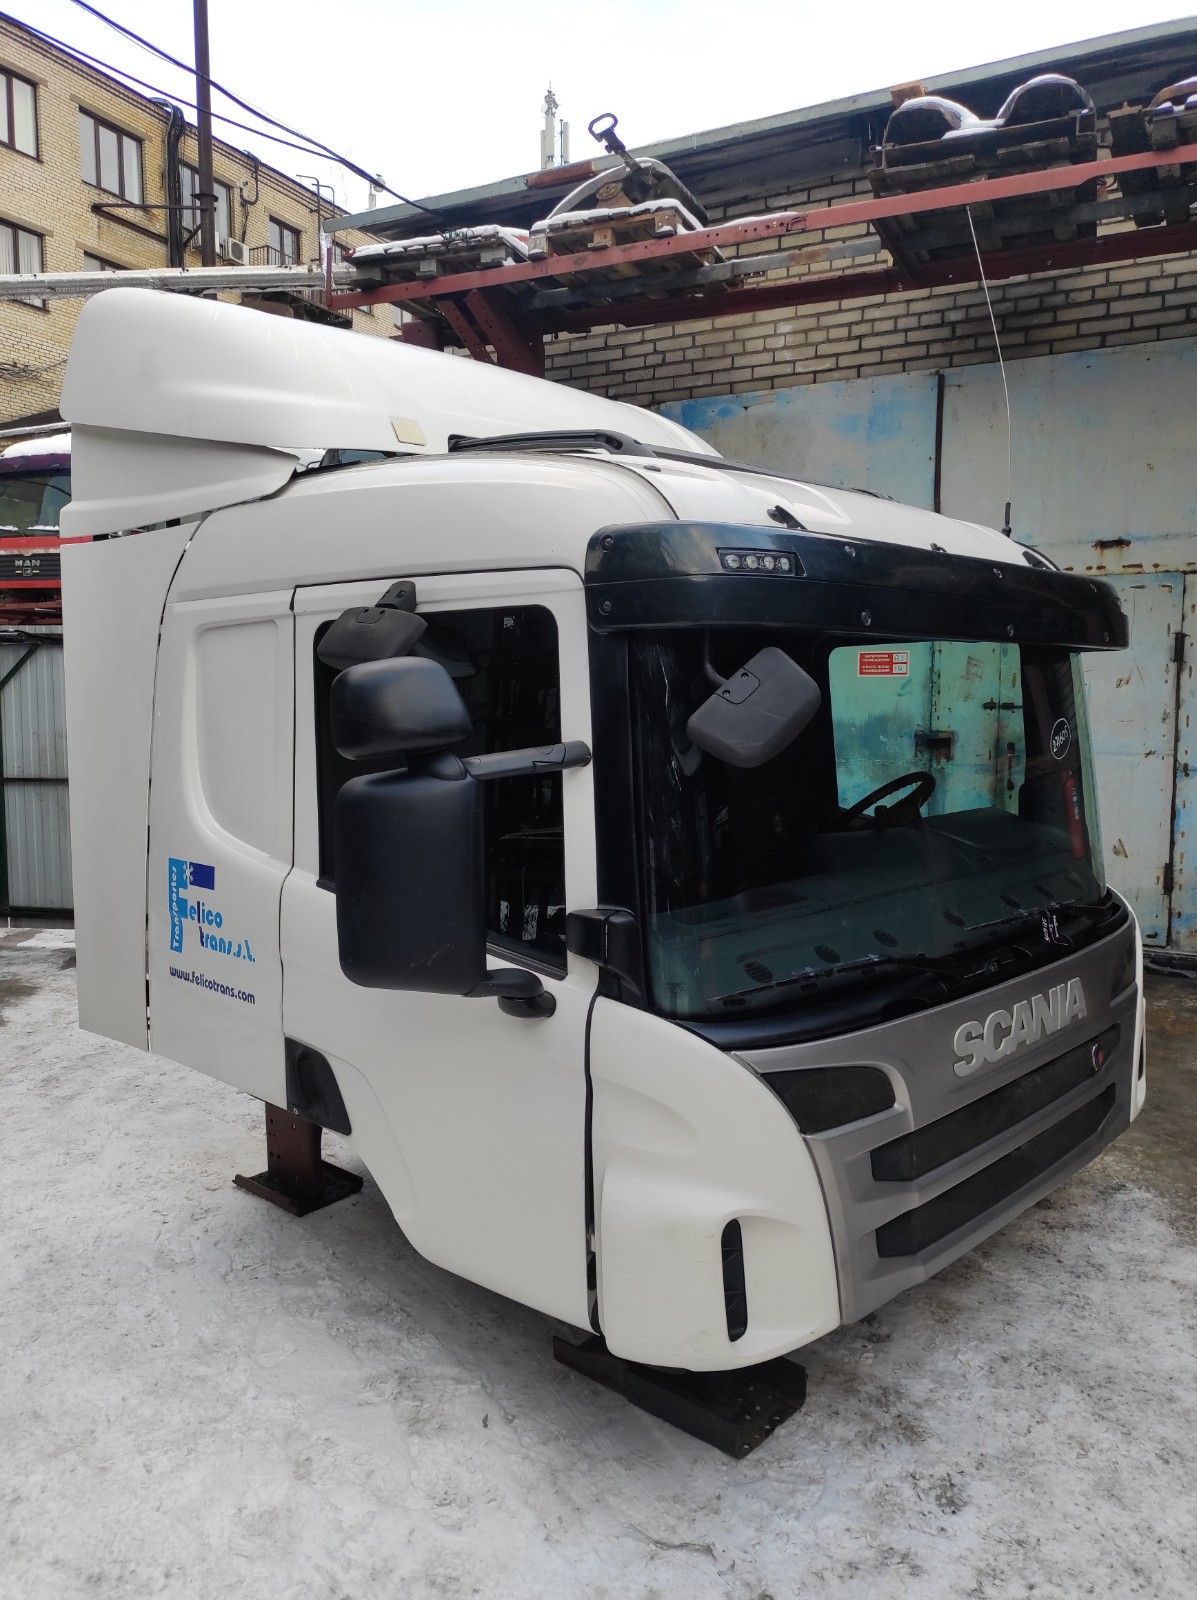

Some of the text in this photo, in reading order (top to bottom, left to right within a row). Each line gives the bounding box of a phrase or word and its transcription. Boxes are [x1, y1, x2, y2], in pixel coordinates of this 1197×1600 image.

[14, 559, 41, 567] MAN
[169, 965, 256, 1005] www.felicotrans.com
[953, 976, 1088, 1078] SCANIA
